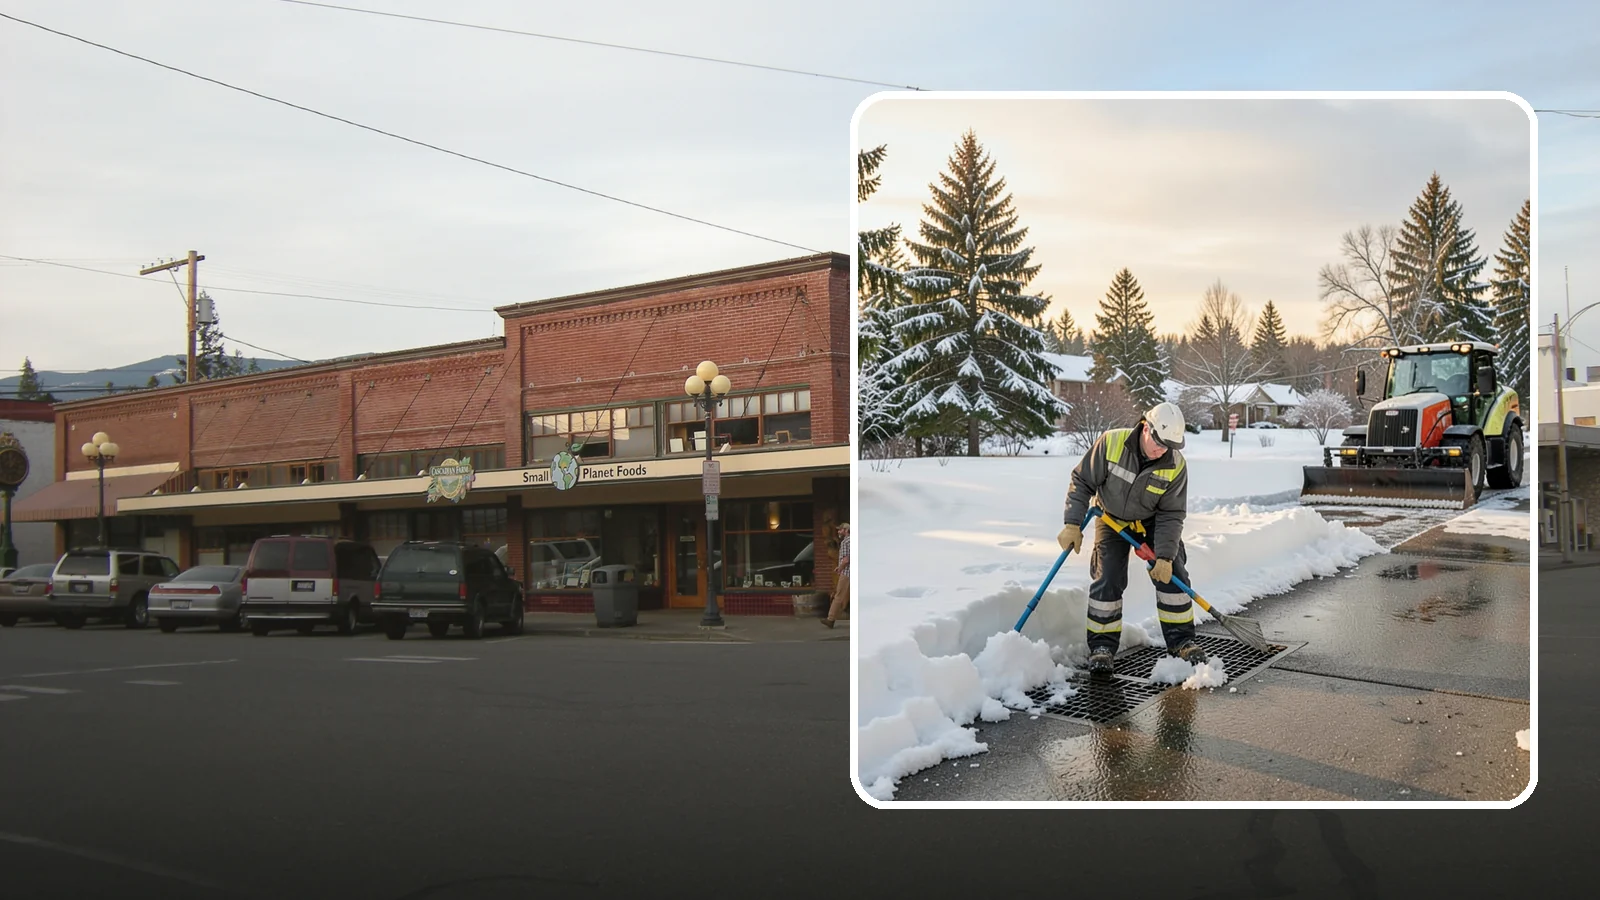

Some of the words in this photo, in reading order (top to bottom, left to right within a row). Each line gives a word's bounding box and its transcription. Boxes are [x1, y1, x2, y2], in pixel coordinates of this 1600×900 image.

[523, 470, 549, 482] Small
[583, 468, 614, 479] Planet
[617, 464, 647, 477] Foods
